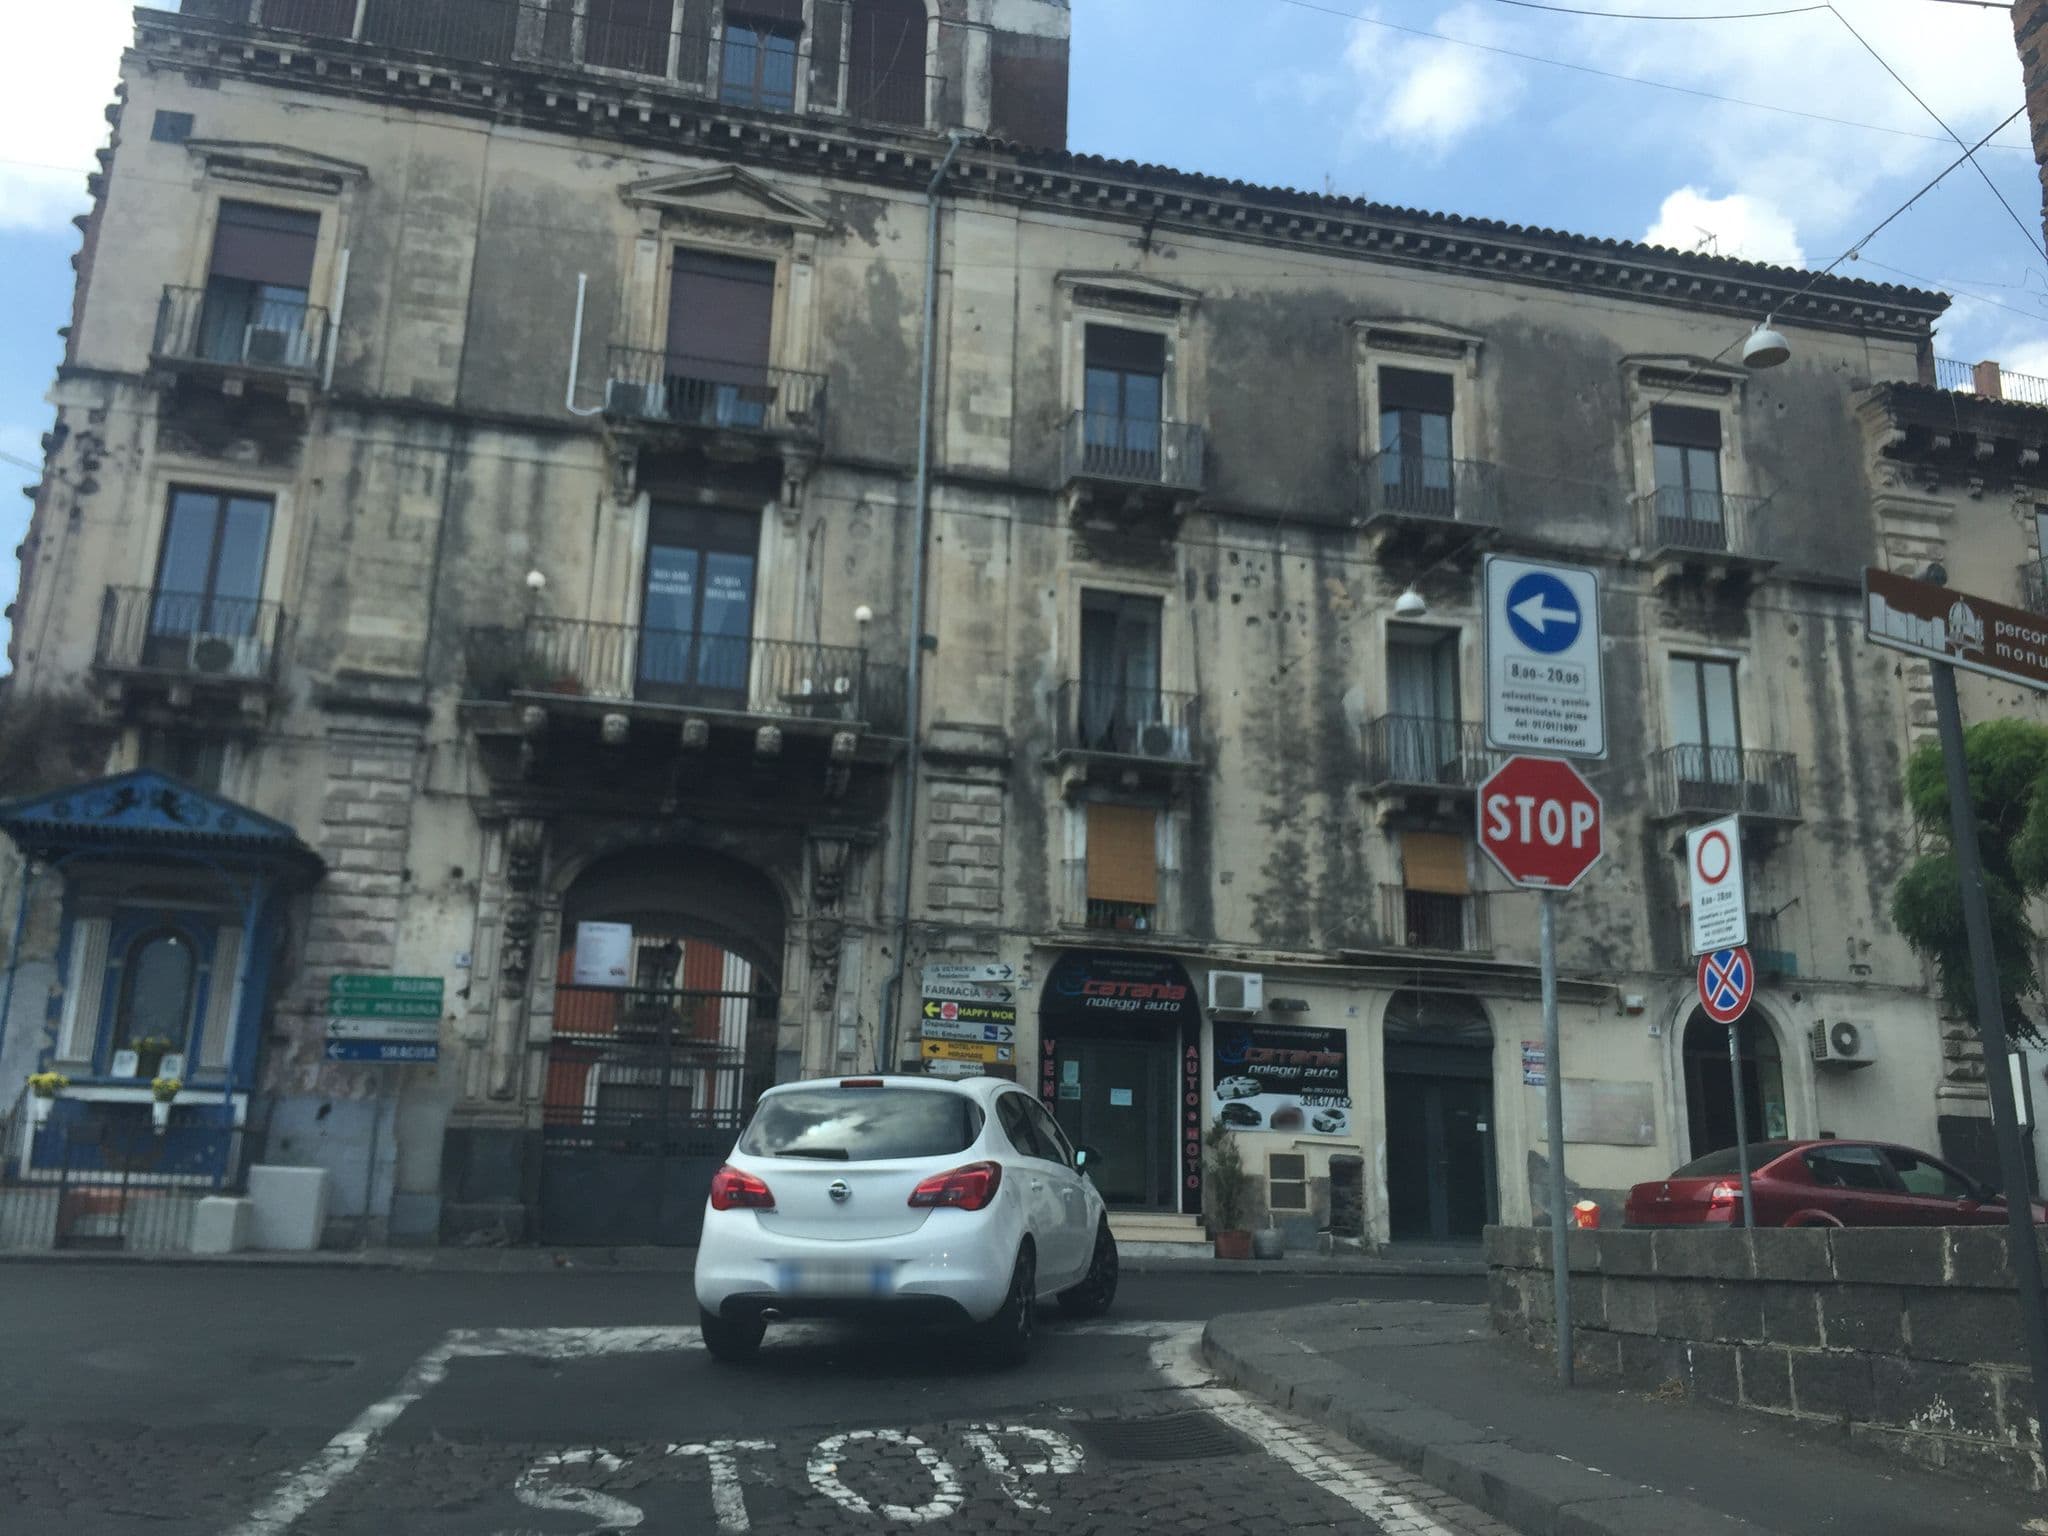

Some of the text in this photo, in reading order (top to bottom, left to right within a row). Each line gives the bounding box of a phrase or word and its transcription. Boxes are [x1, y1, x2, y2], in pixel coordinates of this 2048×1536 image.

[1995, 620, 2048, 647] percor
[1487, 793, 1595, 848] STOP
[925, 984, 981, 998] FARMACIA
[1086, 997, 1181, 1012] noleggi auto
[959, 1006, 1015, 1021] HAPPY WOK
[1248, 1064, 1339, 1079] noleggi auto
[515, 1422, 1086, 1532] STOP
